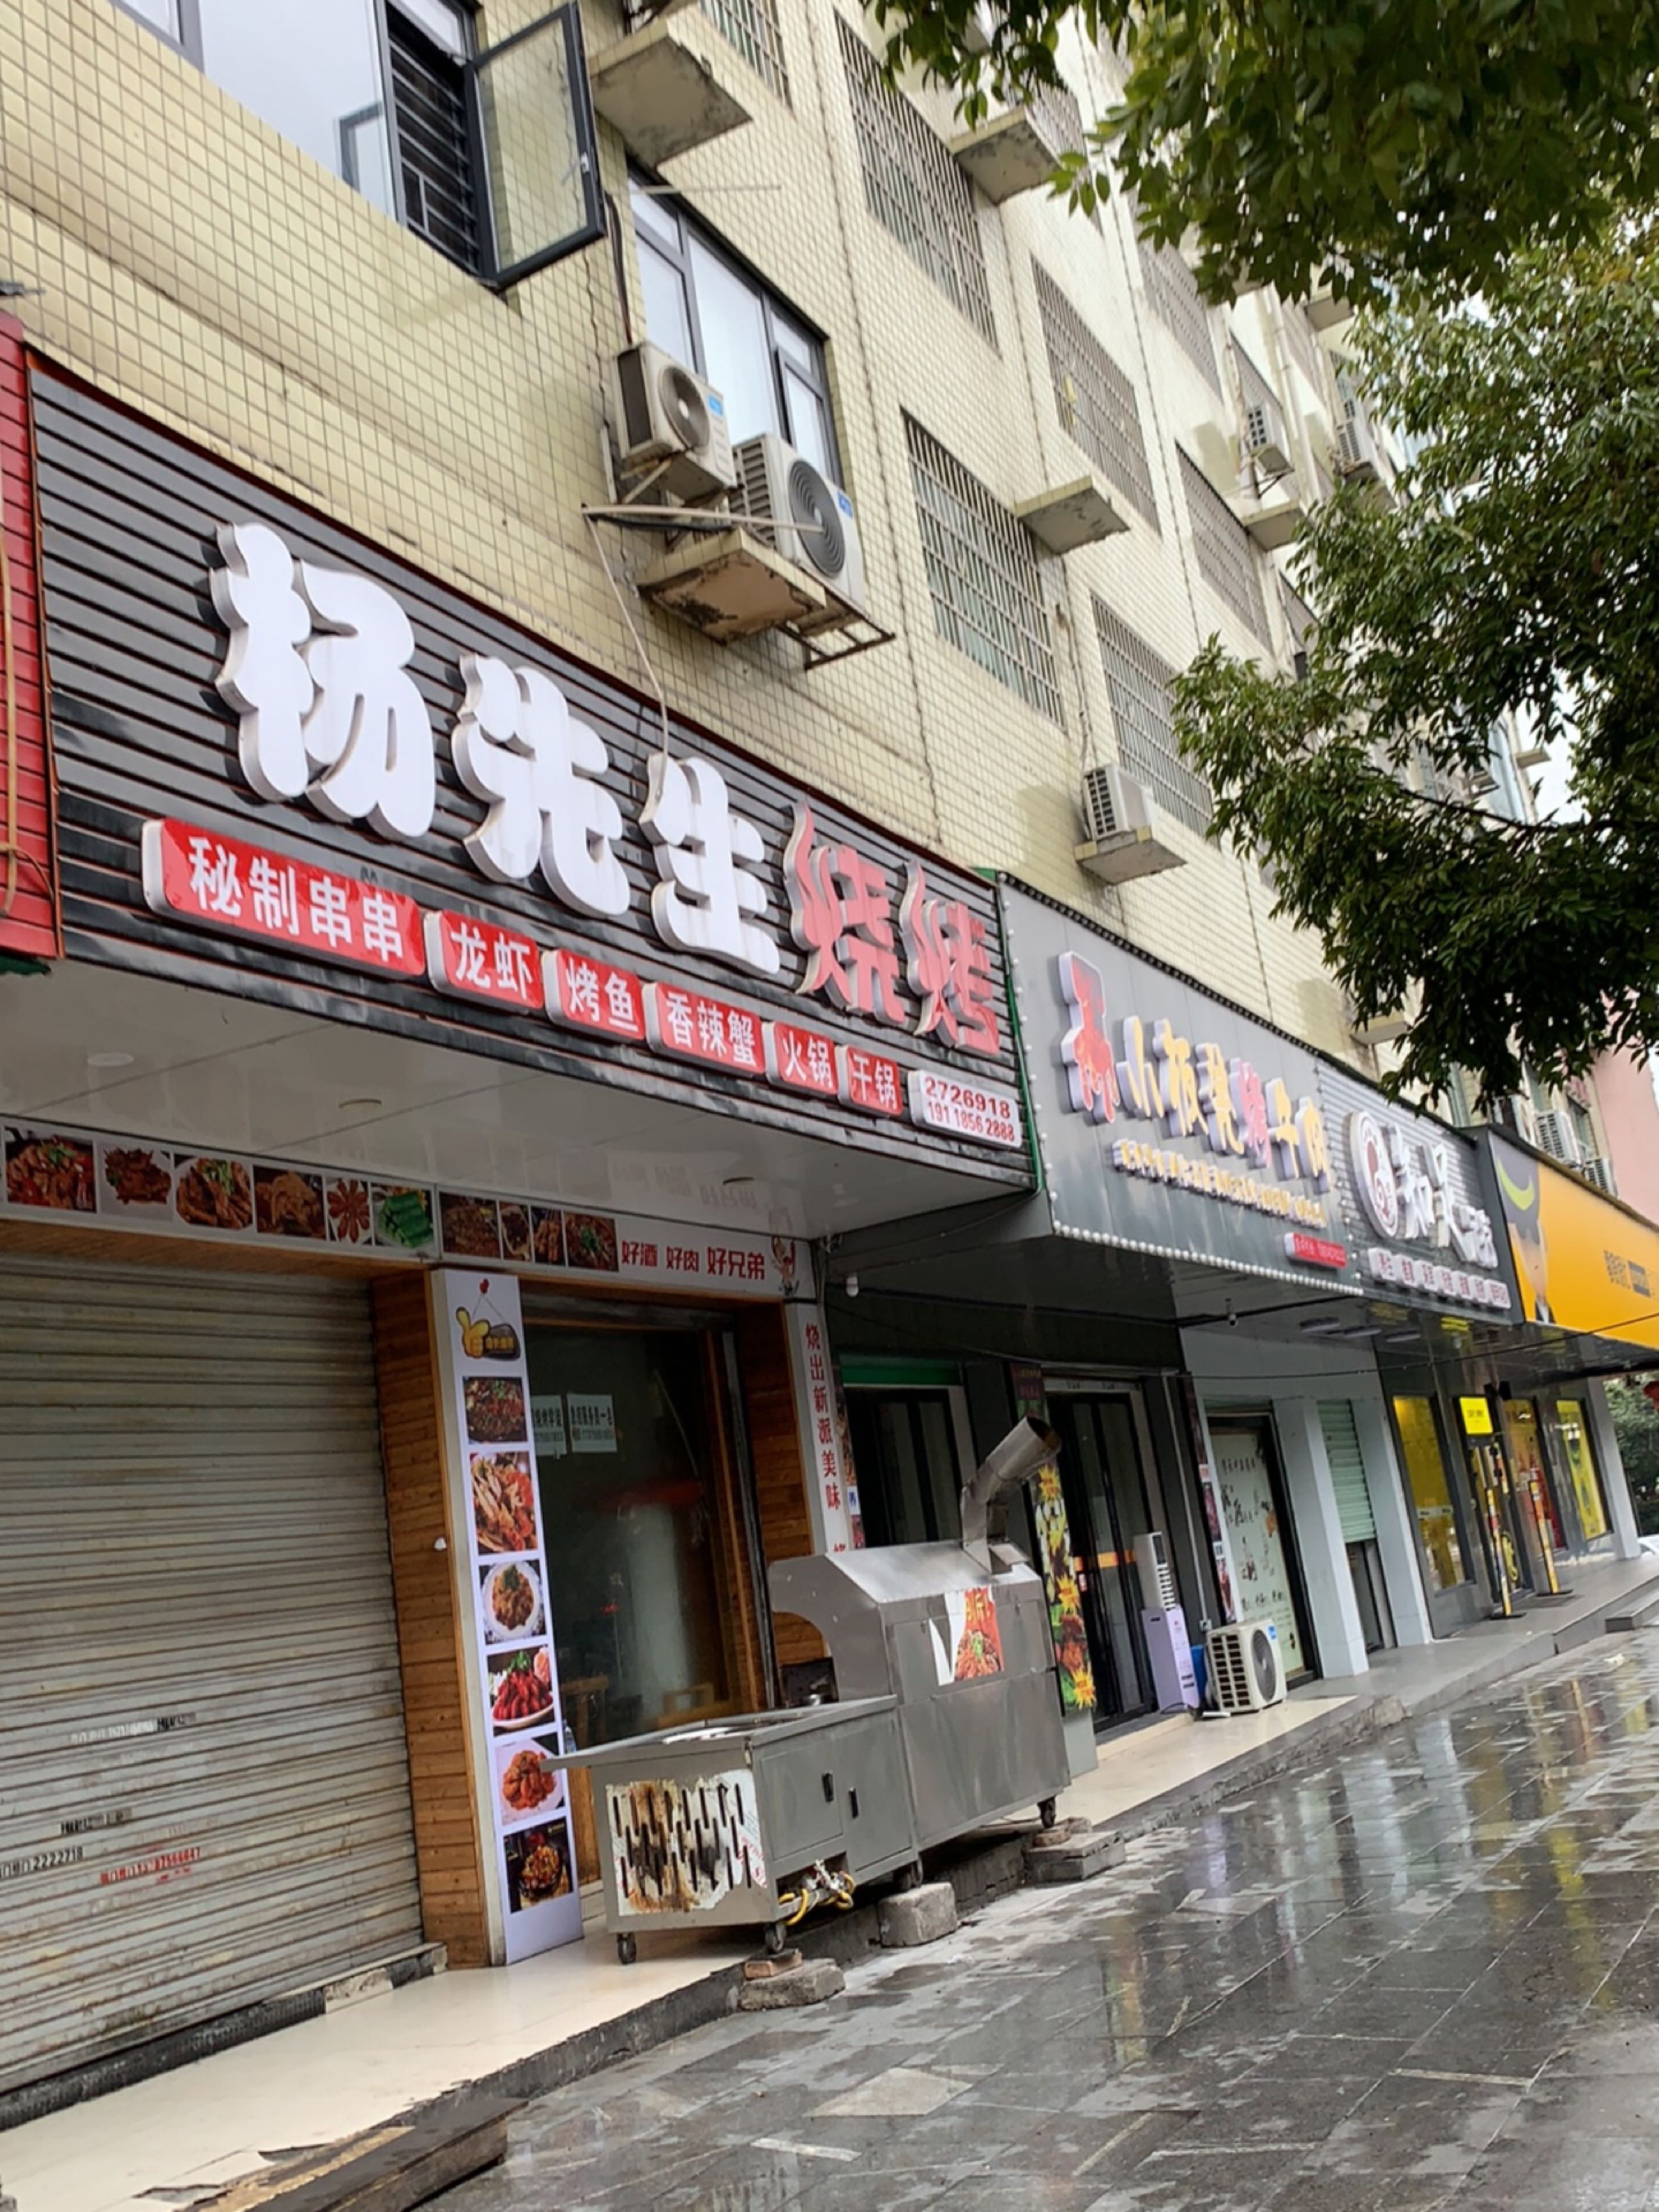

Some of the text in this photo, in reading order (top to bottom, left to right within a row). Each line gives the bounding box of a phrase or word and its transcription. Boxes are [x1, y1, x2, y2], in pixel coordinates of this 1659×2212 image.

[188, 836, 898, 1109] 秘制串串 龙虾 烤鱼 香辣蟹 火锅 干锅
[925, 1076, 1011, 1119] 2726918
[621, 1240, 765, 1281] 好酒 好肉 好兄弟
